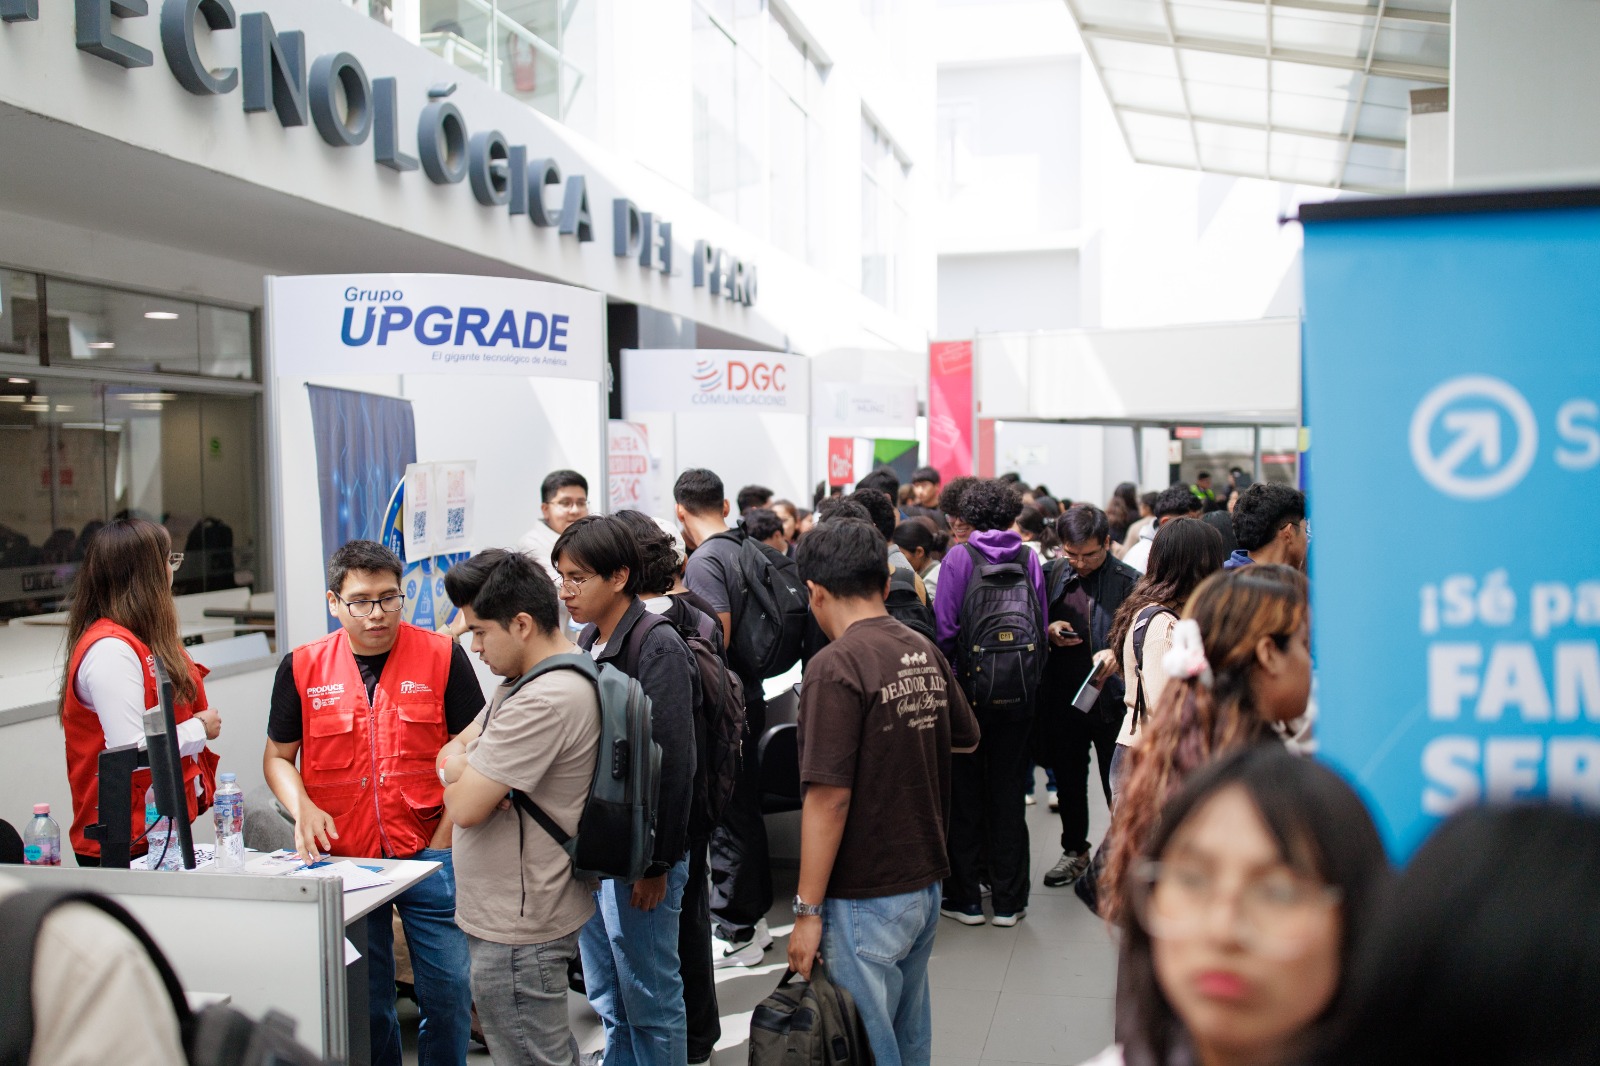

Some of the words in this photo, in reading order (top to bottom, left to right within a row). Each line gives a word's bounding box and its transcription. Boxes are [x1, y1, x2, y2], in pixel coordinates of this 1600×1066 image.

[0, 0, 594, 242] ECNOLÓGICA
[613, 198, 682, 277] DEL
[344, 286, 403, 303] Grupo
[341, 305, 570, 352] UPGRADE
[432, 351, 442, 360] El
[444, 353, 480, 363] gigante
[483, 352, 530, 365] tecnológico
[727, 360, 786, 391] DGC
[307, 683, 344, 695] PRODUCE
